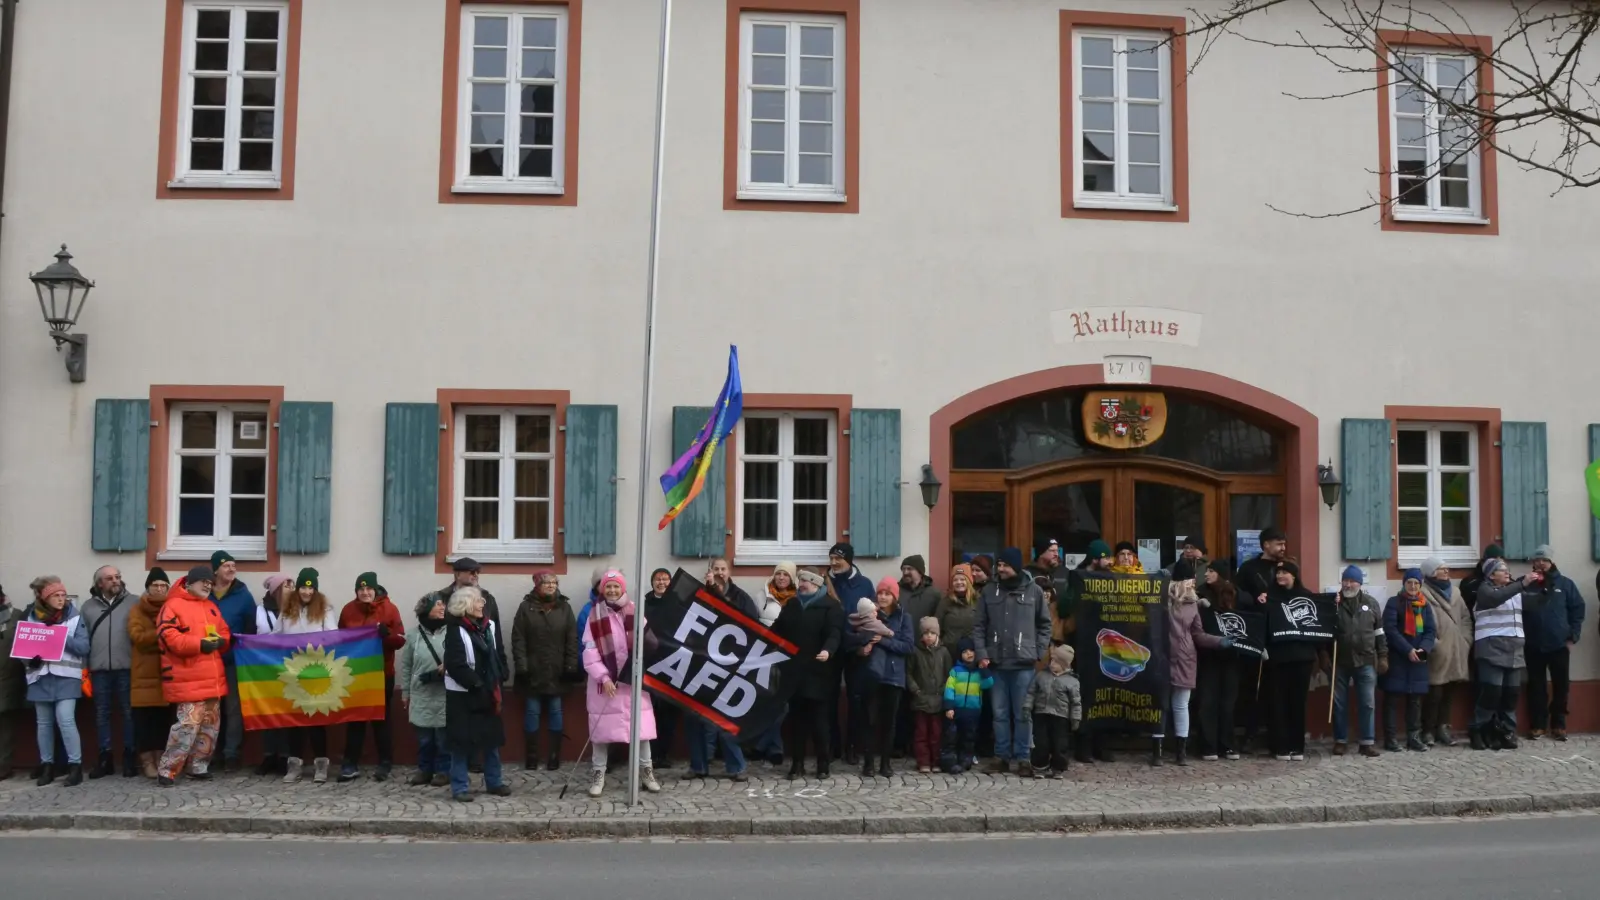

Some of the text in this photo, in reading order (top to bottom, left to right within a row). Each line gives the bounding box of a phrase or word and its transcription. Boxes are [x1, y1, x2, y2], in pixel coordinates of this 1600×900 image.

[1069, 310, 1180, 341] Rathaus
[1108, 361, 1145, 376] 1719
[1083, 579, 1162, 594] TURBOJUGEND IS
[31, 627, 55, 635] WIEDER
[673, 601, 791, 690] FCK
[646, 645, 757, 718] AFD
[1095, 687, 1152, 706] BUT FOREVER
[1086, 703, 1162, 723] AGAINST RACISM!
